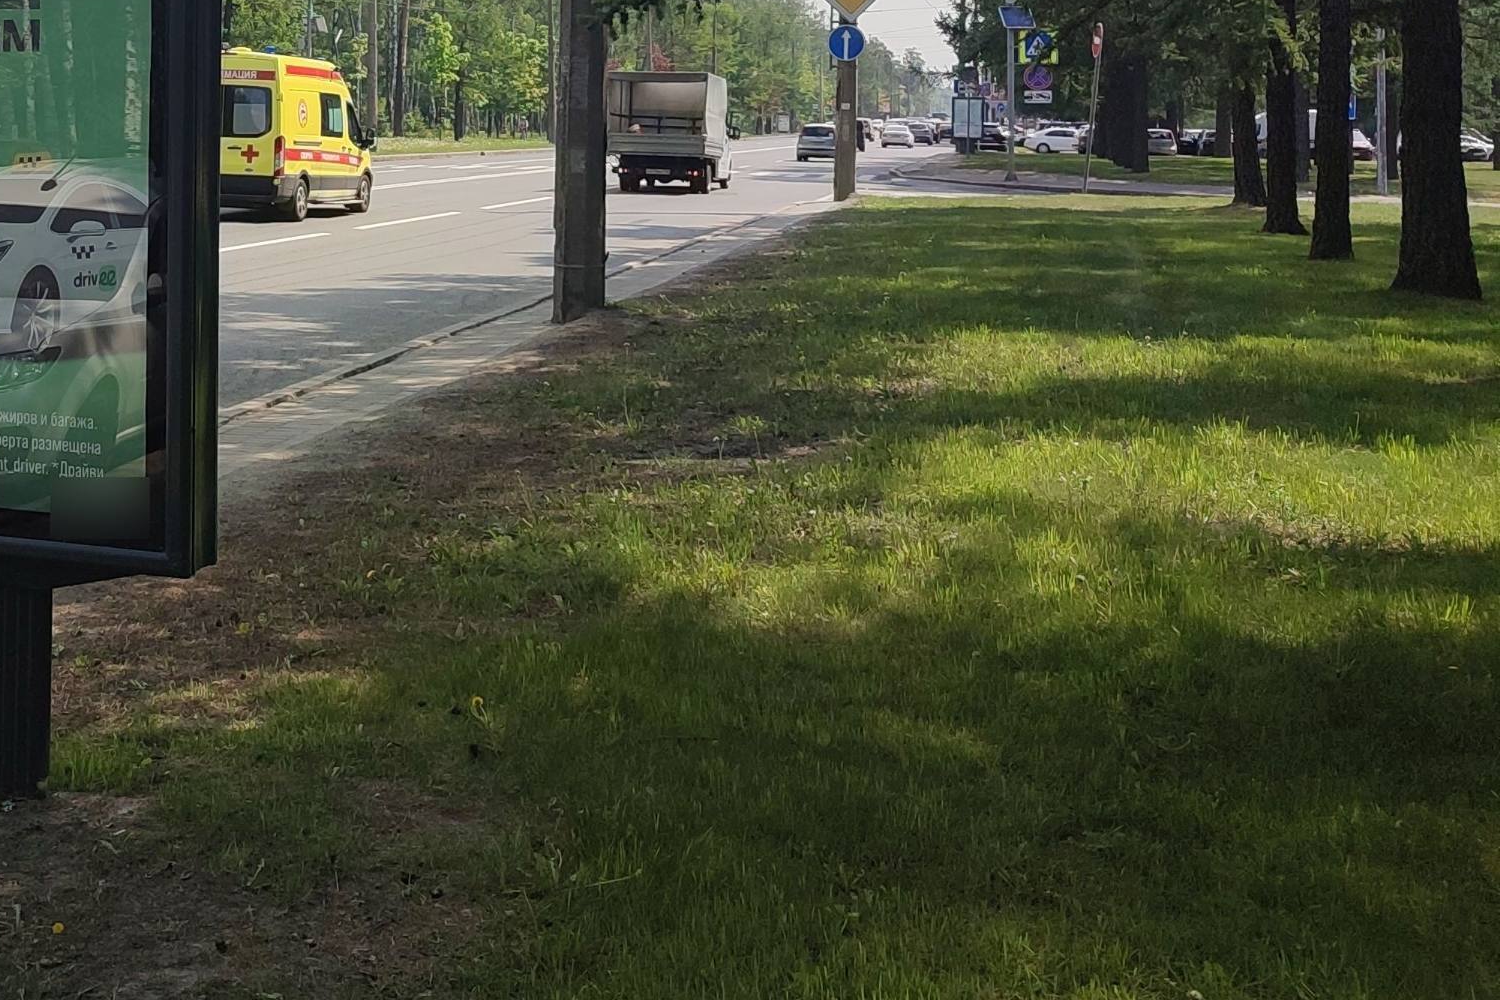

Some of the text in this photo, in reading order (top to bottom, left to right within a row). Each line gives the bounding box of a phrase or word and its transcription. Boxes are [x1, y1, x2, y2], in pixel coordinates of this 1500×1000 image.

[222, 70, 258, 79] МАЦИЯ
[73, 270, 117, 288] drivee
[41, 414, 48, 426] и
[50, 412, 98, 430] багажа.
[31, 437, 101, 455] размещена
